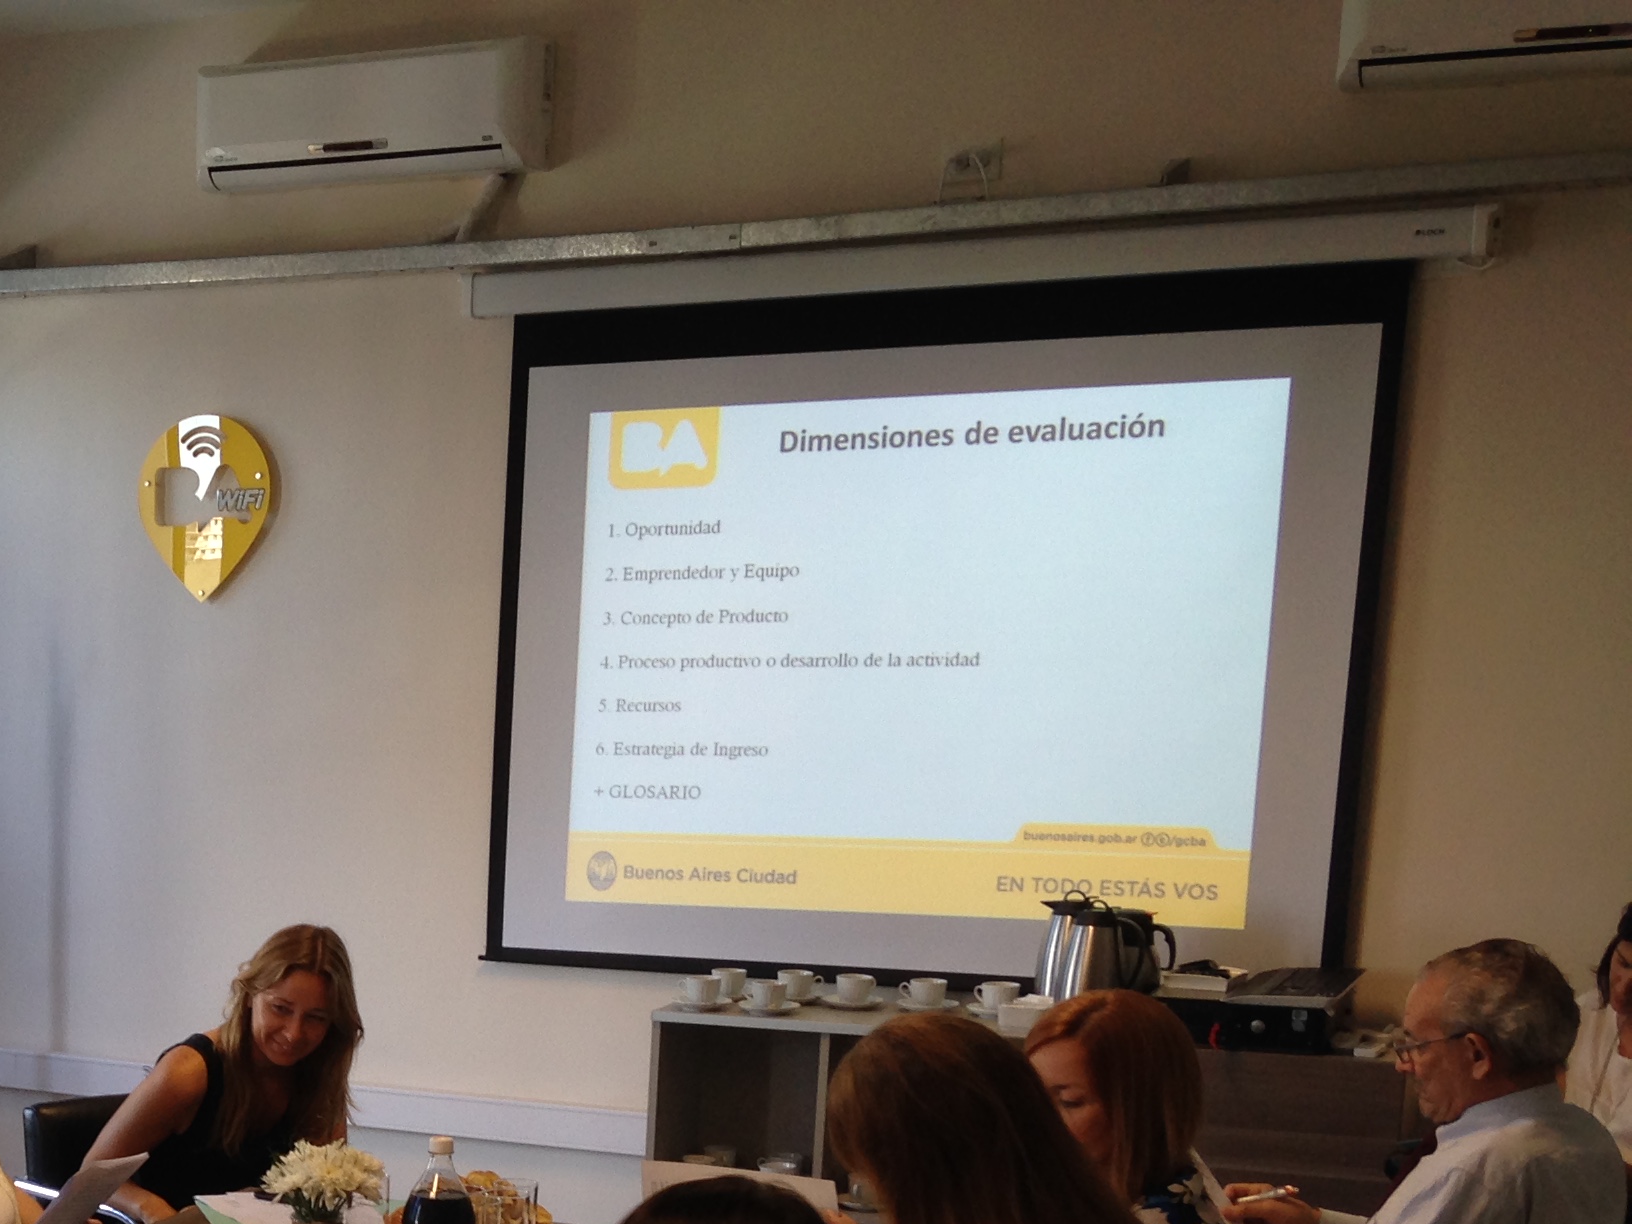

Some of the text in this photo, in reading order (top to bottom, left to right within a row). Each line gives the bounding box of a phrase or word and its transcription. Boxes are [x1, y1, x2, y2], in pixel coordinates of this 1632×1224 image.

[779, 412, 1165, 453] Dimensiones de evaluación
[622, 420, 708, 475] BA
[217, 488, 265, 511] WiFi
[608, 519, 721, 541] 1. Oportunidad
[604, 563, 800, 586] 2. Emprendedor y Equipo
[601, 608, 789, 629] 3. Concepto de Producto
[598, 652, 980, 673] 4. Proceso productivo o desarrollo de la actividad
[597, 698, 682, 714] 5. Recursos
[594, 741, 769, 761] 6. Estrategia de Ingreso
[593, 784, 702, 801] + GLOSARIO
[1169, 834, 1207, 848] /gcba
[623, 864, 798, 885] Buenos Aires Ciudad
[996, 875, 1219, 901] EN TODO ESTÁS VOS
